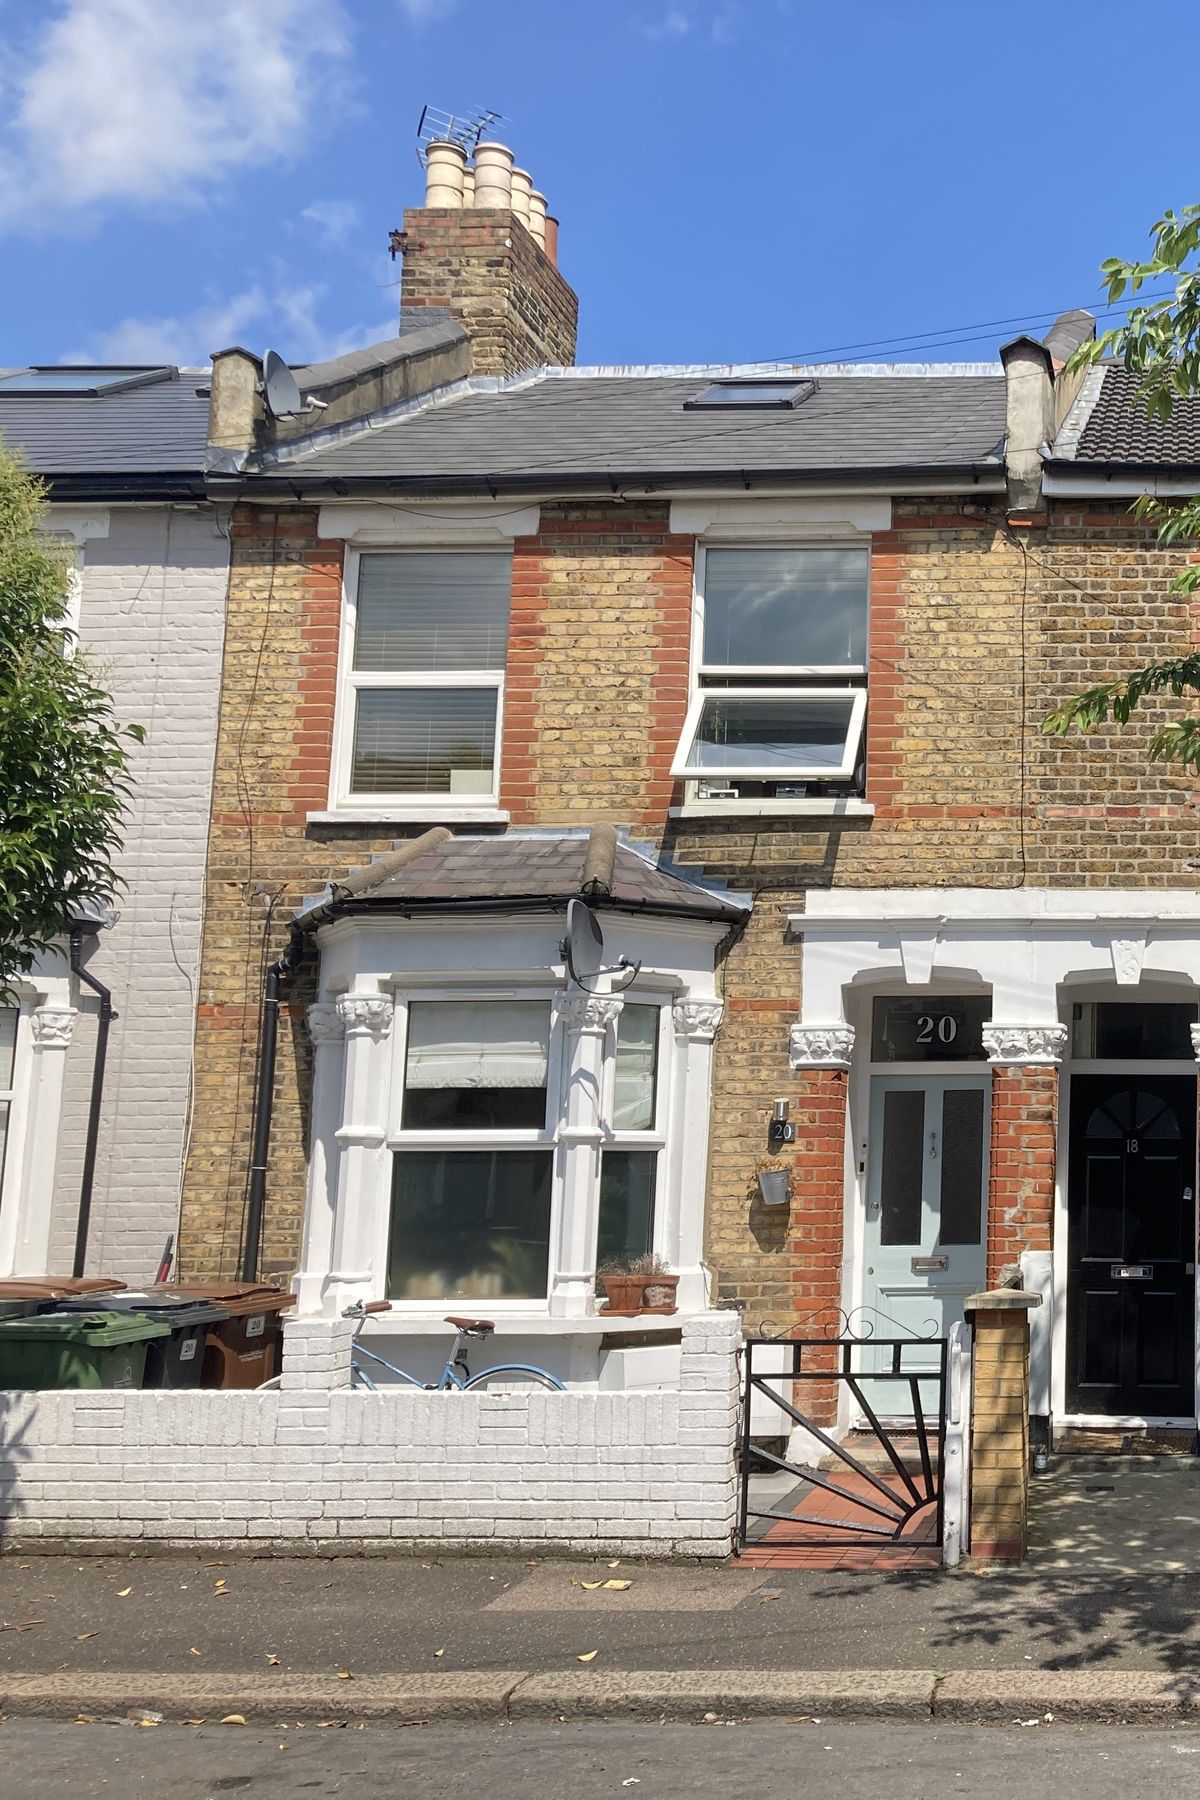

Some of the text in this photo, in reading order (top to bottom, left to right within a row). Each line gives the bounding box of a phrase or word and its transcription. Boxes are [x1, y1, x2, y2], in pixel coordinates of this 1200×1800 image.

[916, 1016, 957, 1043] 20
[775, 1124, 792, 1139] 20
[1126, 1139, 1139, 1153] 18
[251, 1320, 261, 1330] 20
